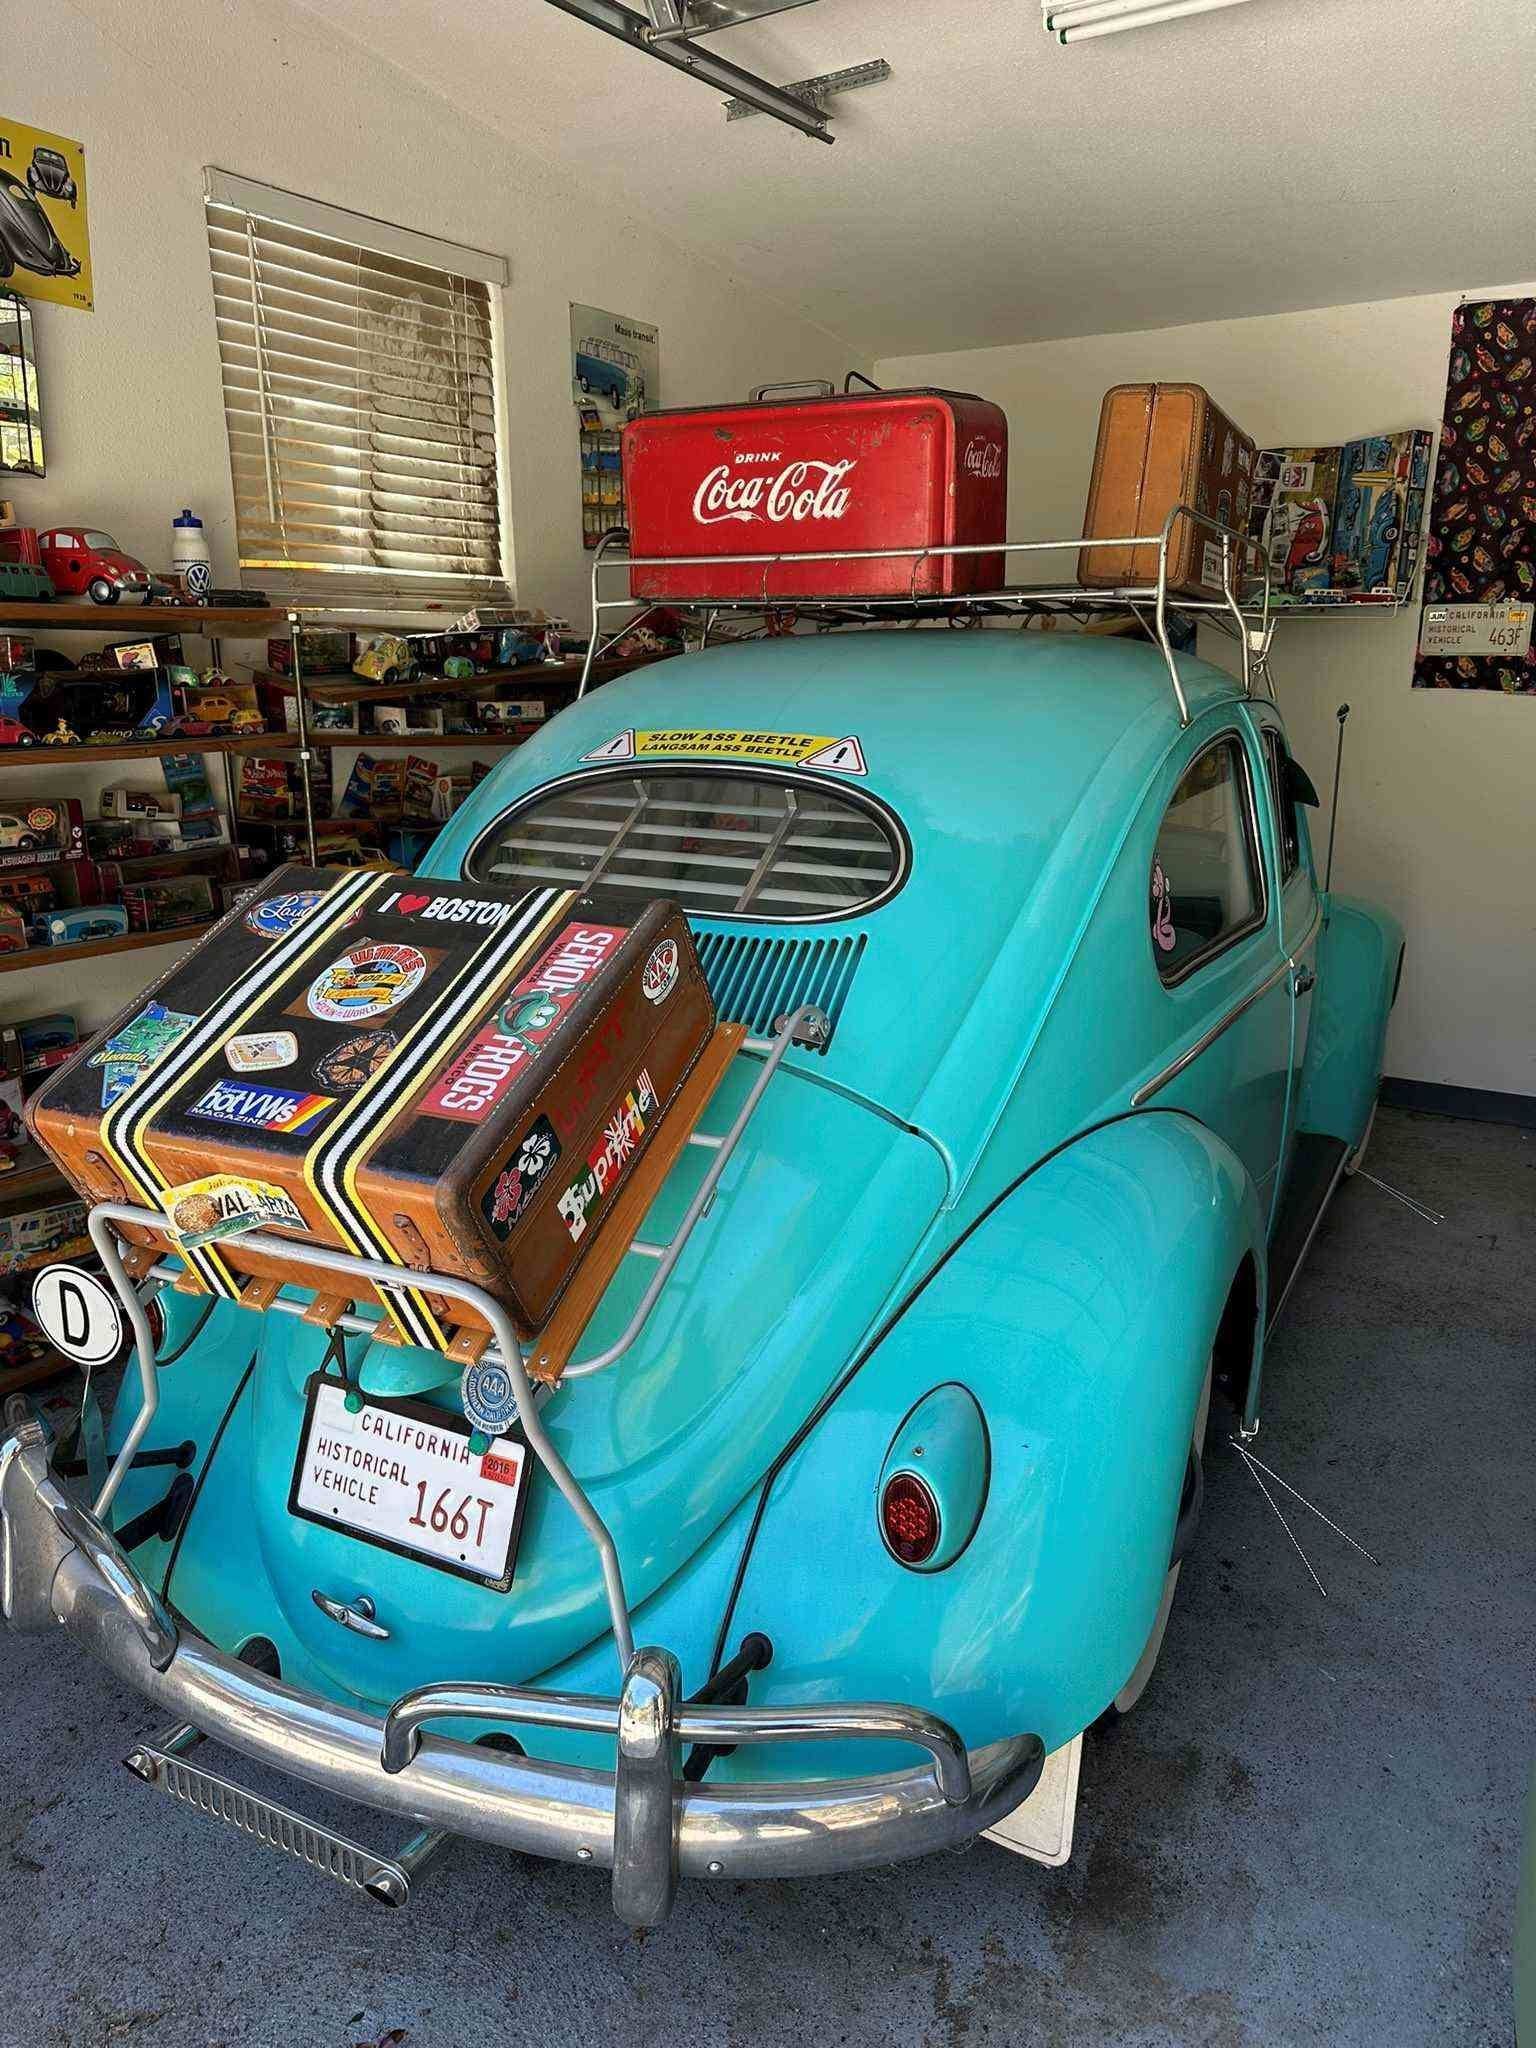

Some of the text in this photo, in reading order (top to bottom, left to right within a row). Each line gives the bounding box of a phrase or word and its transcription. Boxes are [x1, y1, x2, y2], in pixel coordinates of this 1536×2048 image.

[735, 451, 783, 464] DRINK
[692, 459, 858, 524] Coca-Cola
[1427, 636, 1463, 645] VEHICLE
[1428, 624, 1476, 633] HISTORICAL
[1489, 627, 1524, 646] 463F
[641, 742, 803, 758] LANGSAM ASS BEETLE
[648, 732, 814, 748] SLOW ASS BEETLE
[377, 892, 513, 926] I BOSTON
[440, 1033, 528, 1112] FROG'S
[445, 1043, 484, 1085] MEXICO
[191, 1107, 268, 1126] MAGAZINE
[211, 1190, 300, 1218] VALARTA
[59, 1279, 90, 1347] D
[482, 1376, 505, 1399] AAA
[362, 1413, 471, 1465] CALIFORNIA
[317, 1437, 410, 1487] HISTORICAL
[487, 1458, 510, 1474] 2016
[313, 1466, 380, 1505] VEHICLE
[408, 1480, 495, 1547] 166T
